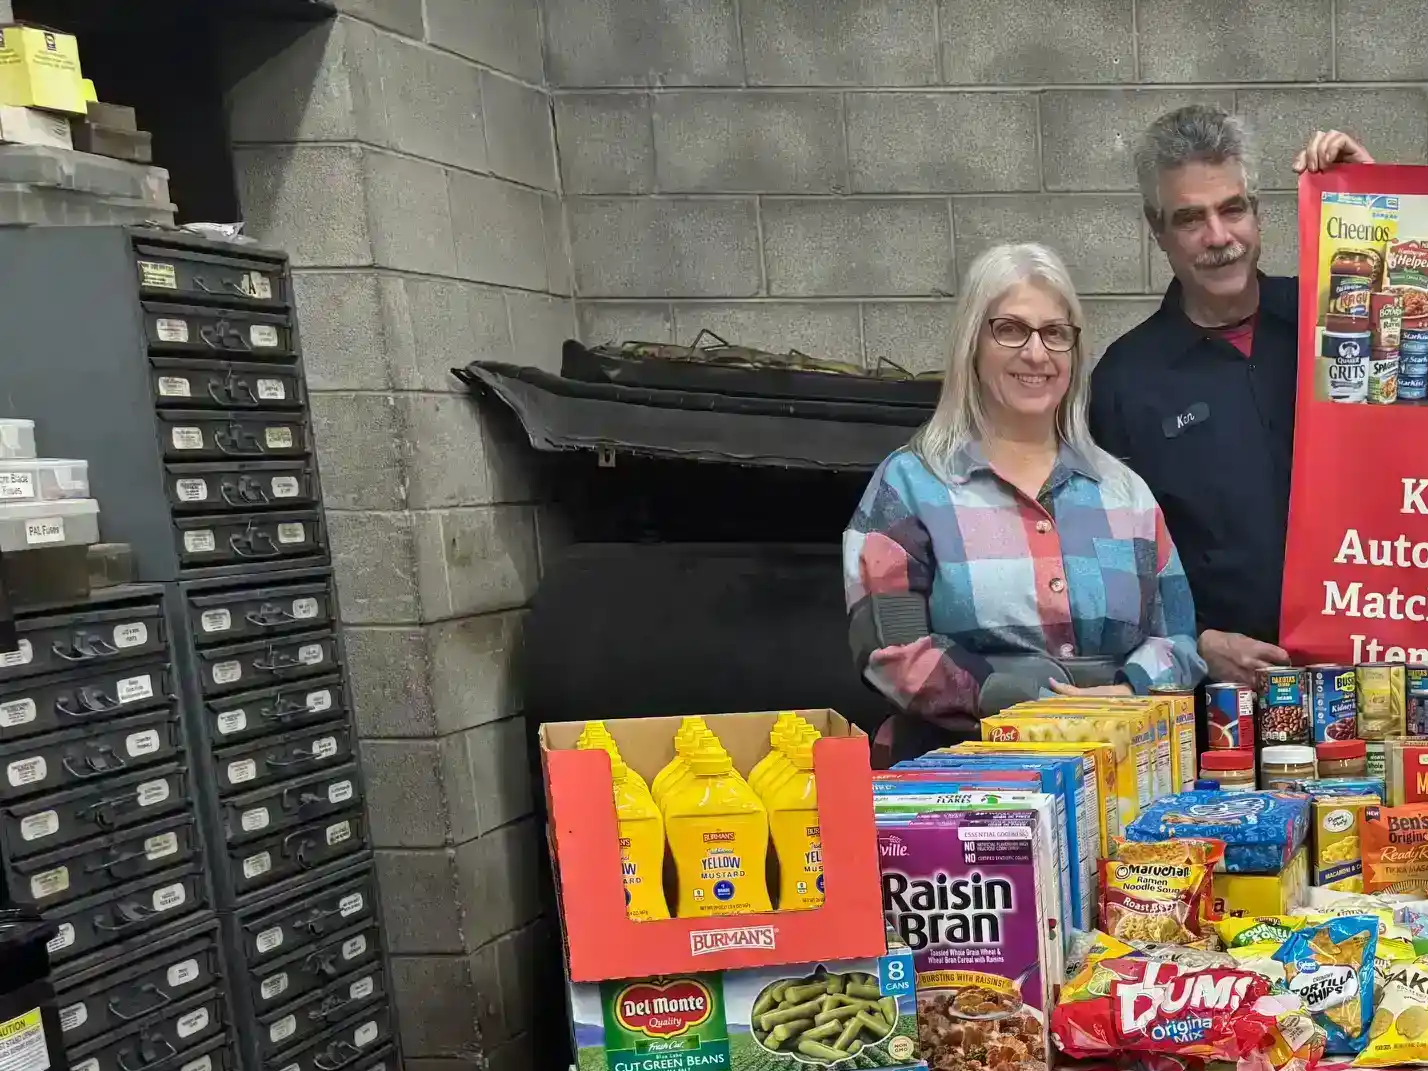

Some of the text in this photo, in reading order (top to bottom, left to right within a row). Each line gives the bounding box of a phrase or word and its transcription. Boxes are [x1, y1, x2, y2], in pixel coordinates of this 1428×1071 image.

[1329, 365, 1365, 380] GRITS
[990, 727, 1018, 742] Post
[702, 856, 741, 870] YELLOW
[701, 869, 746, 879] MUSTARD
[883, 872, 1012, 912] Raisin
[693, 927, 774, 952] BURMAN'S
[899, 912, 1000, 950] Bran
[888, 962, 905, 981] 8
[886, 980, 909, 991] CANS
[1307, 986, 1342, 1005] CHIPS
[625, 994, 704, 1017] Del Monte
[649, 1016, 682, 1028] Quality
[643, 1058, 683, 1071] GREEN
[687, 1052, 725, 1066] BEANS
